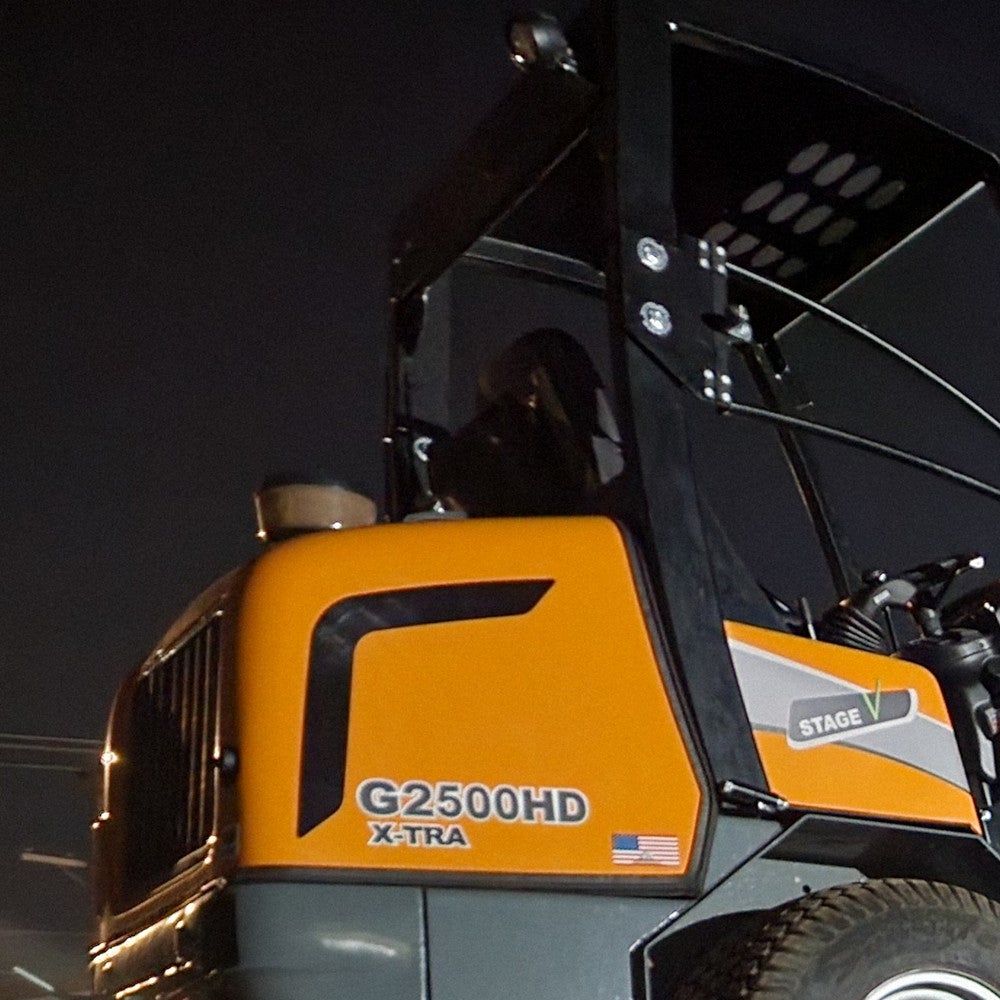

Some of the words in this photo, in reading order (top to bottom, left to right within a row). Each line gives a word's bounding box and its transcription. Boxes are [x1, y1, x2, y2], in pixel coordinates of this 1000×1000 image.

[798, 707, 863, 738] STAGE
[861, 678, 883, 722] V
[356, 777, 590, 826] G2500HD
[367, 821, 472, 849] X-TRA
